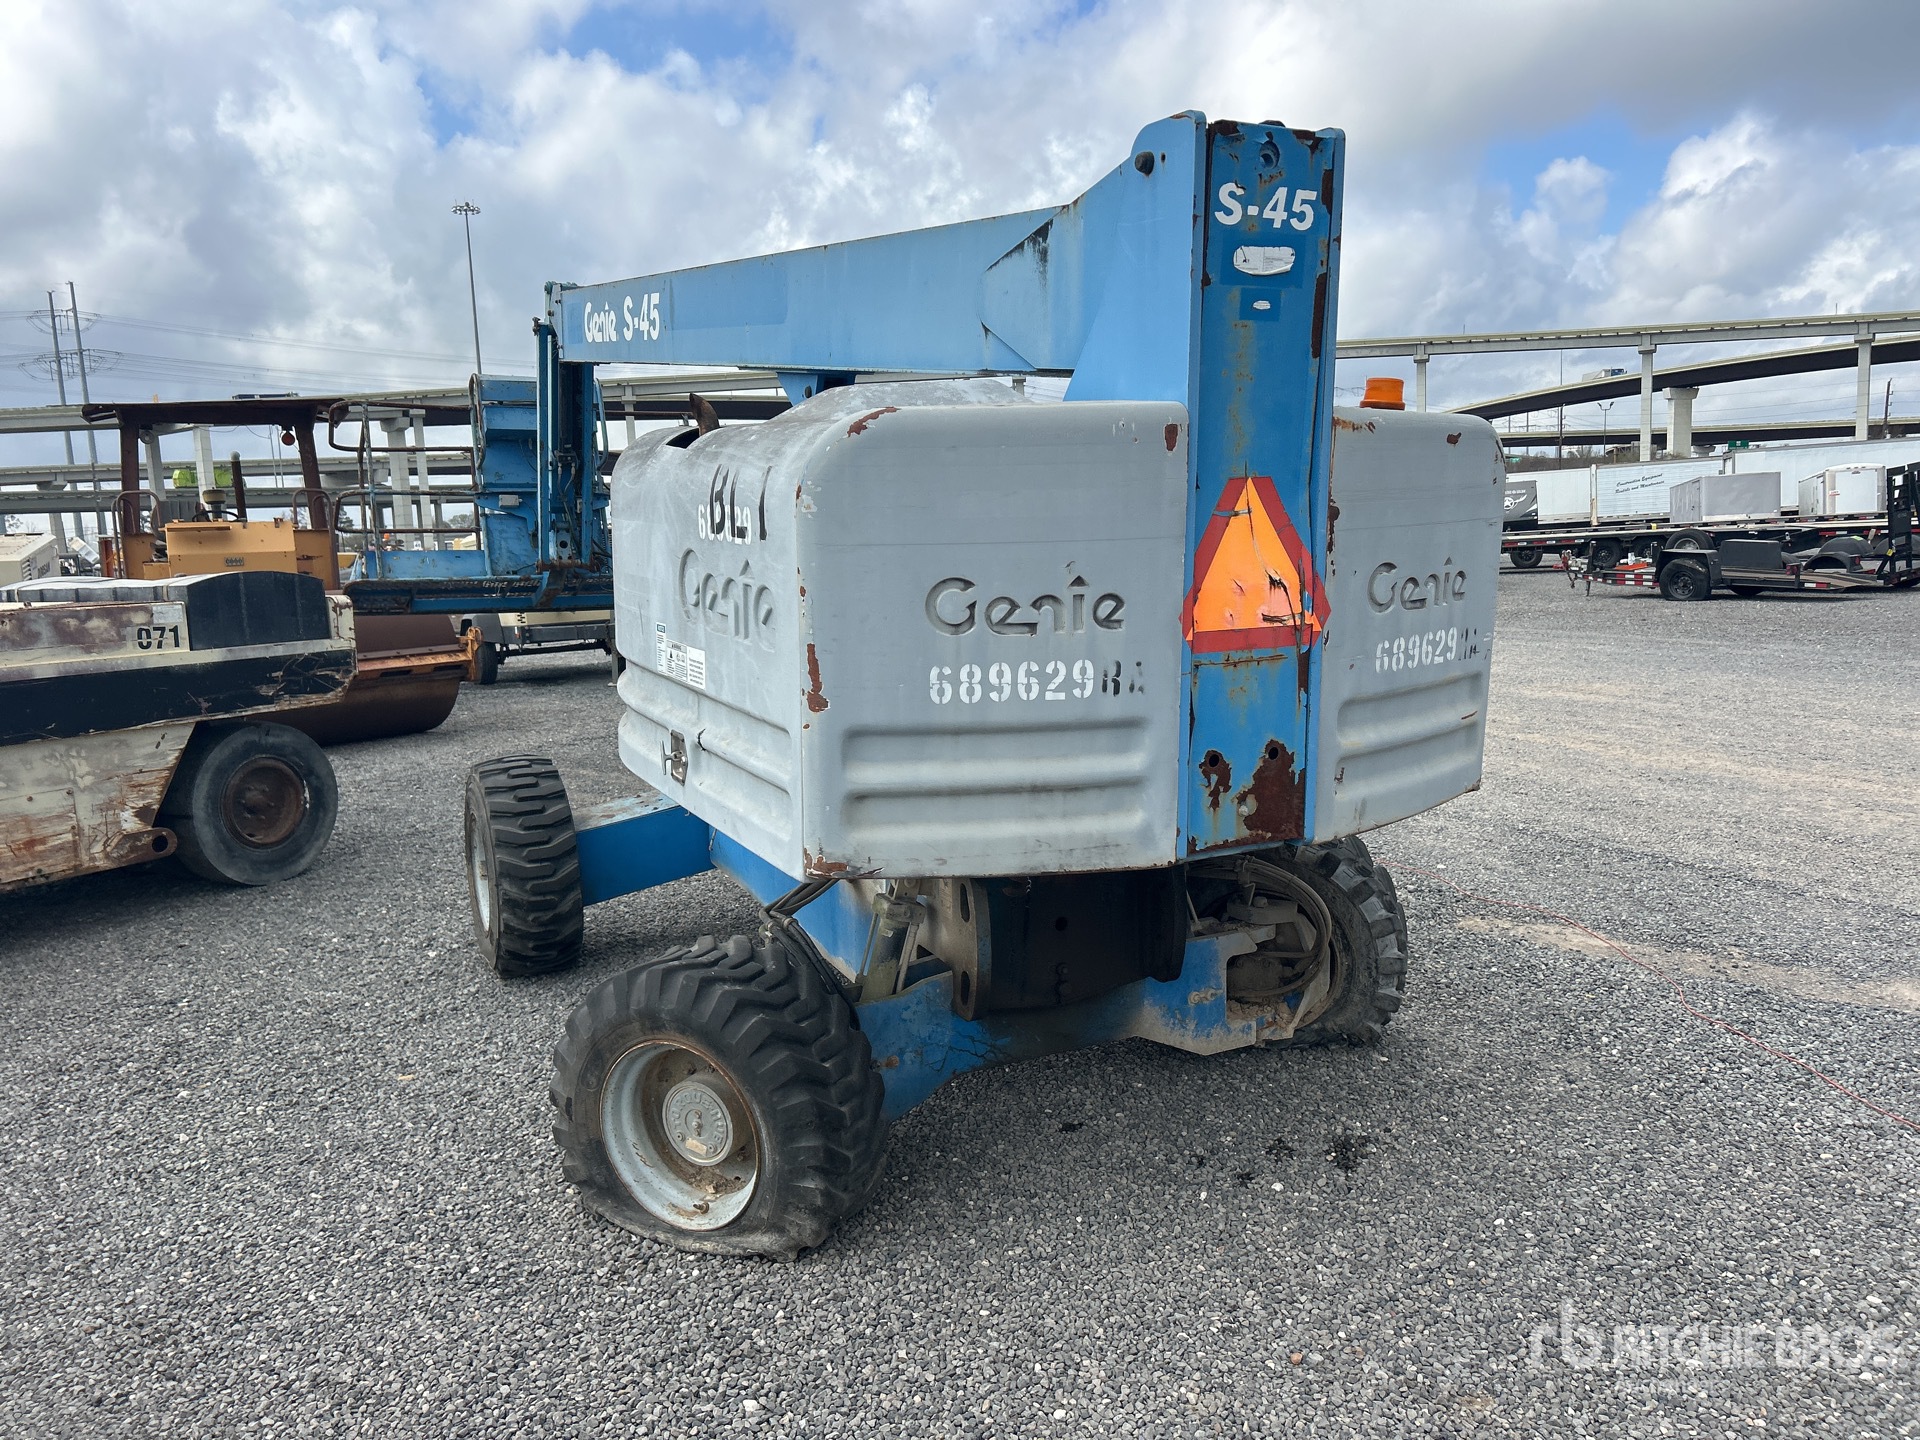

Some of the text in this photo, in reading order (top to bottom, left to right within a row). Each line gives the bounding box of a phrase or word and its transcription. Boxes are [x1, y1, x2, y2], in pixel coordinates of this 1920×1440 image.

[1214, 182, 1317, 231] S-45
[584, 293, 660, 343] Genie S-45
[678, 547, 777, 653] Genie
[924, 575, 1126, 637] Genie
[1366, 556, 1467, 614] Genie
[136, 624, 180, 650] 071
[1375, 626, 1458, 673] 689629
[929, 659, 1094, 705] 689629
